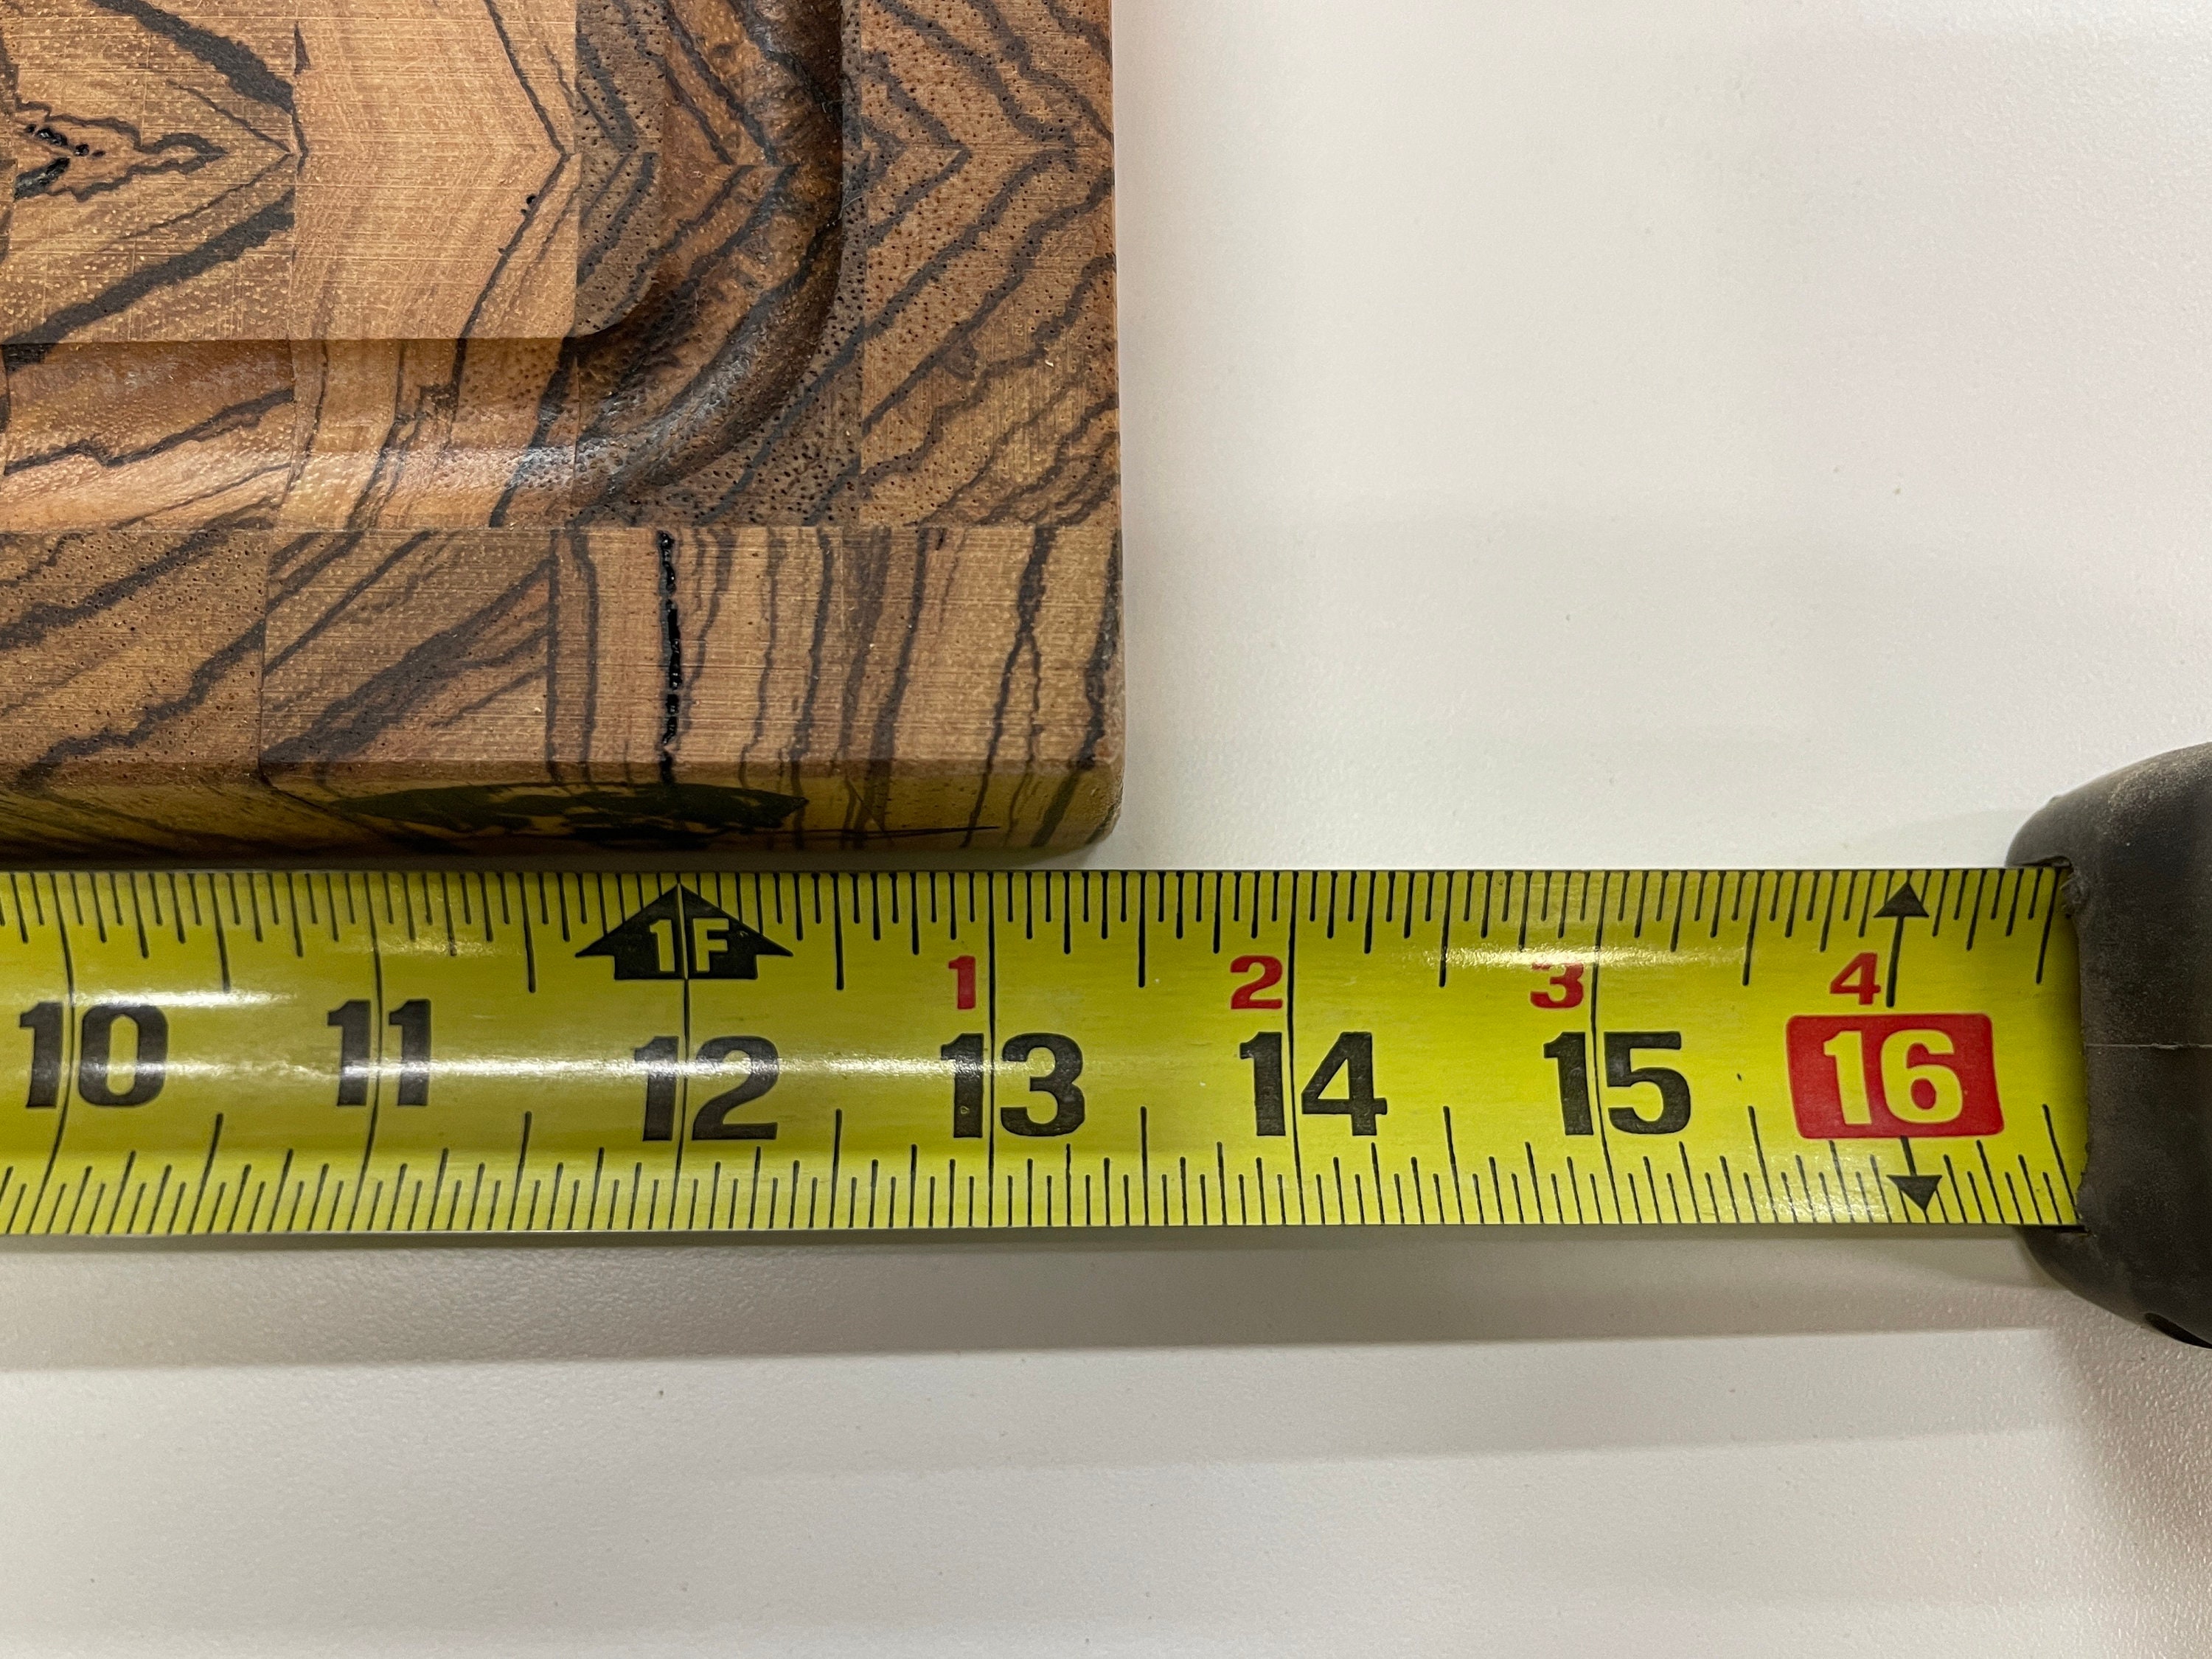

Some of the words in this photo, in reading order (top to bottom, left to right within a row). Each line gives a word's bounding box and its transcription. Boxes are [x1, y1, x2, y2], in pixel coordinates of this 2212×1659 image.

[650, 918, 730, 974] 1F
[948, 955, 977, 1010] 1
[1229, 955, 1283, 1009] 2
[1529, 957, 1585, 1009] 3
[1829, 952, 1882, 1006] 4
[19, 1001, 169, 1108] 10
[327, 999, 432, 1107] 11
[634, 1035, 779, 1141] 12
[941, 1032, 1086, 1138] 13
[1239, 1031, 1388, 1136] 14
[1543, 1031, 1691, 1135] 15
[1823, 1029, 1964, 1126] 16
